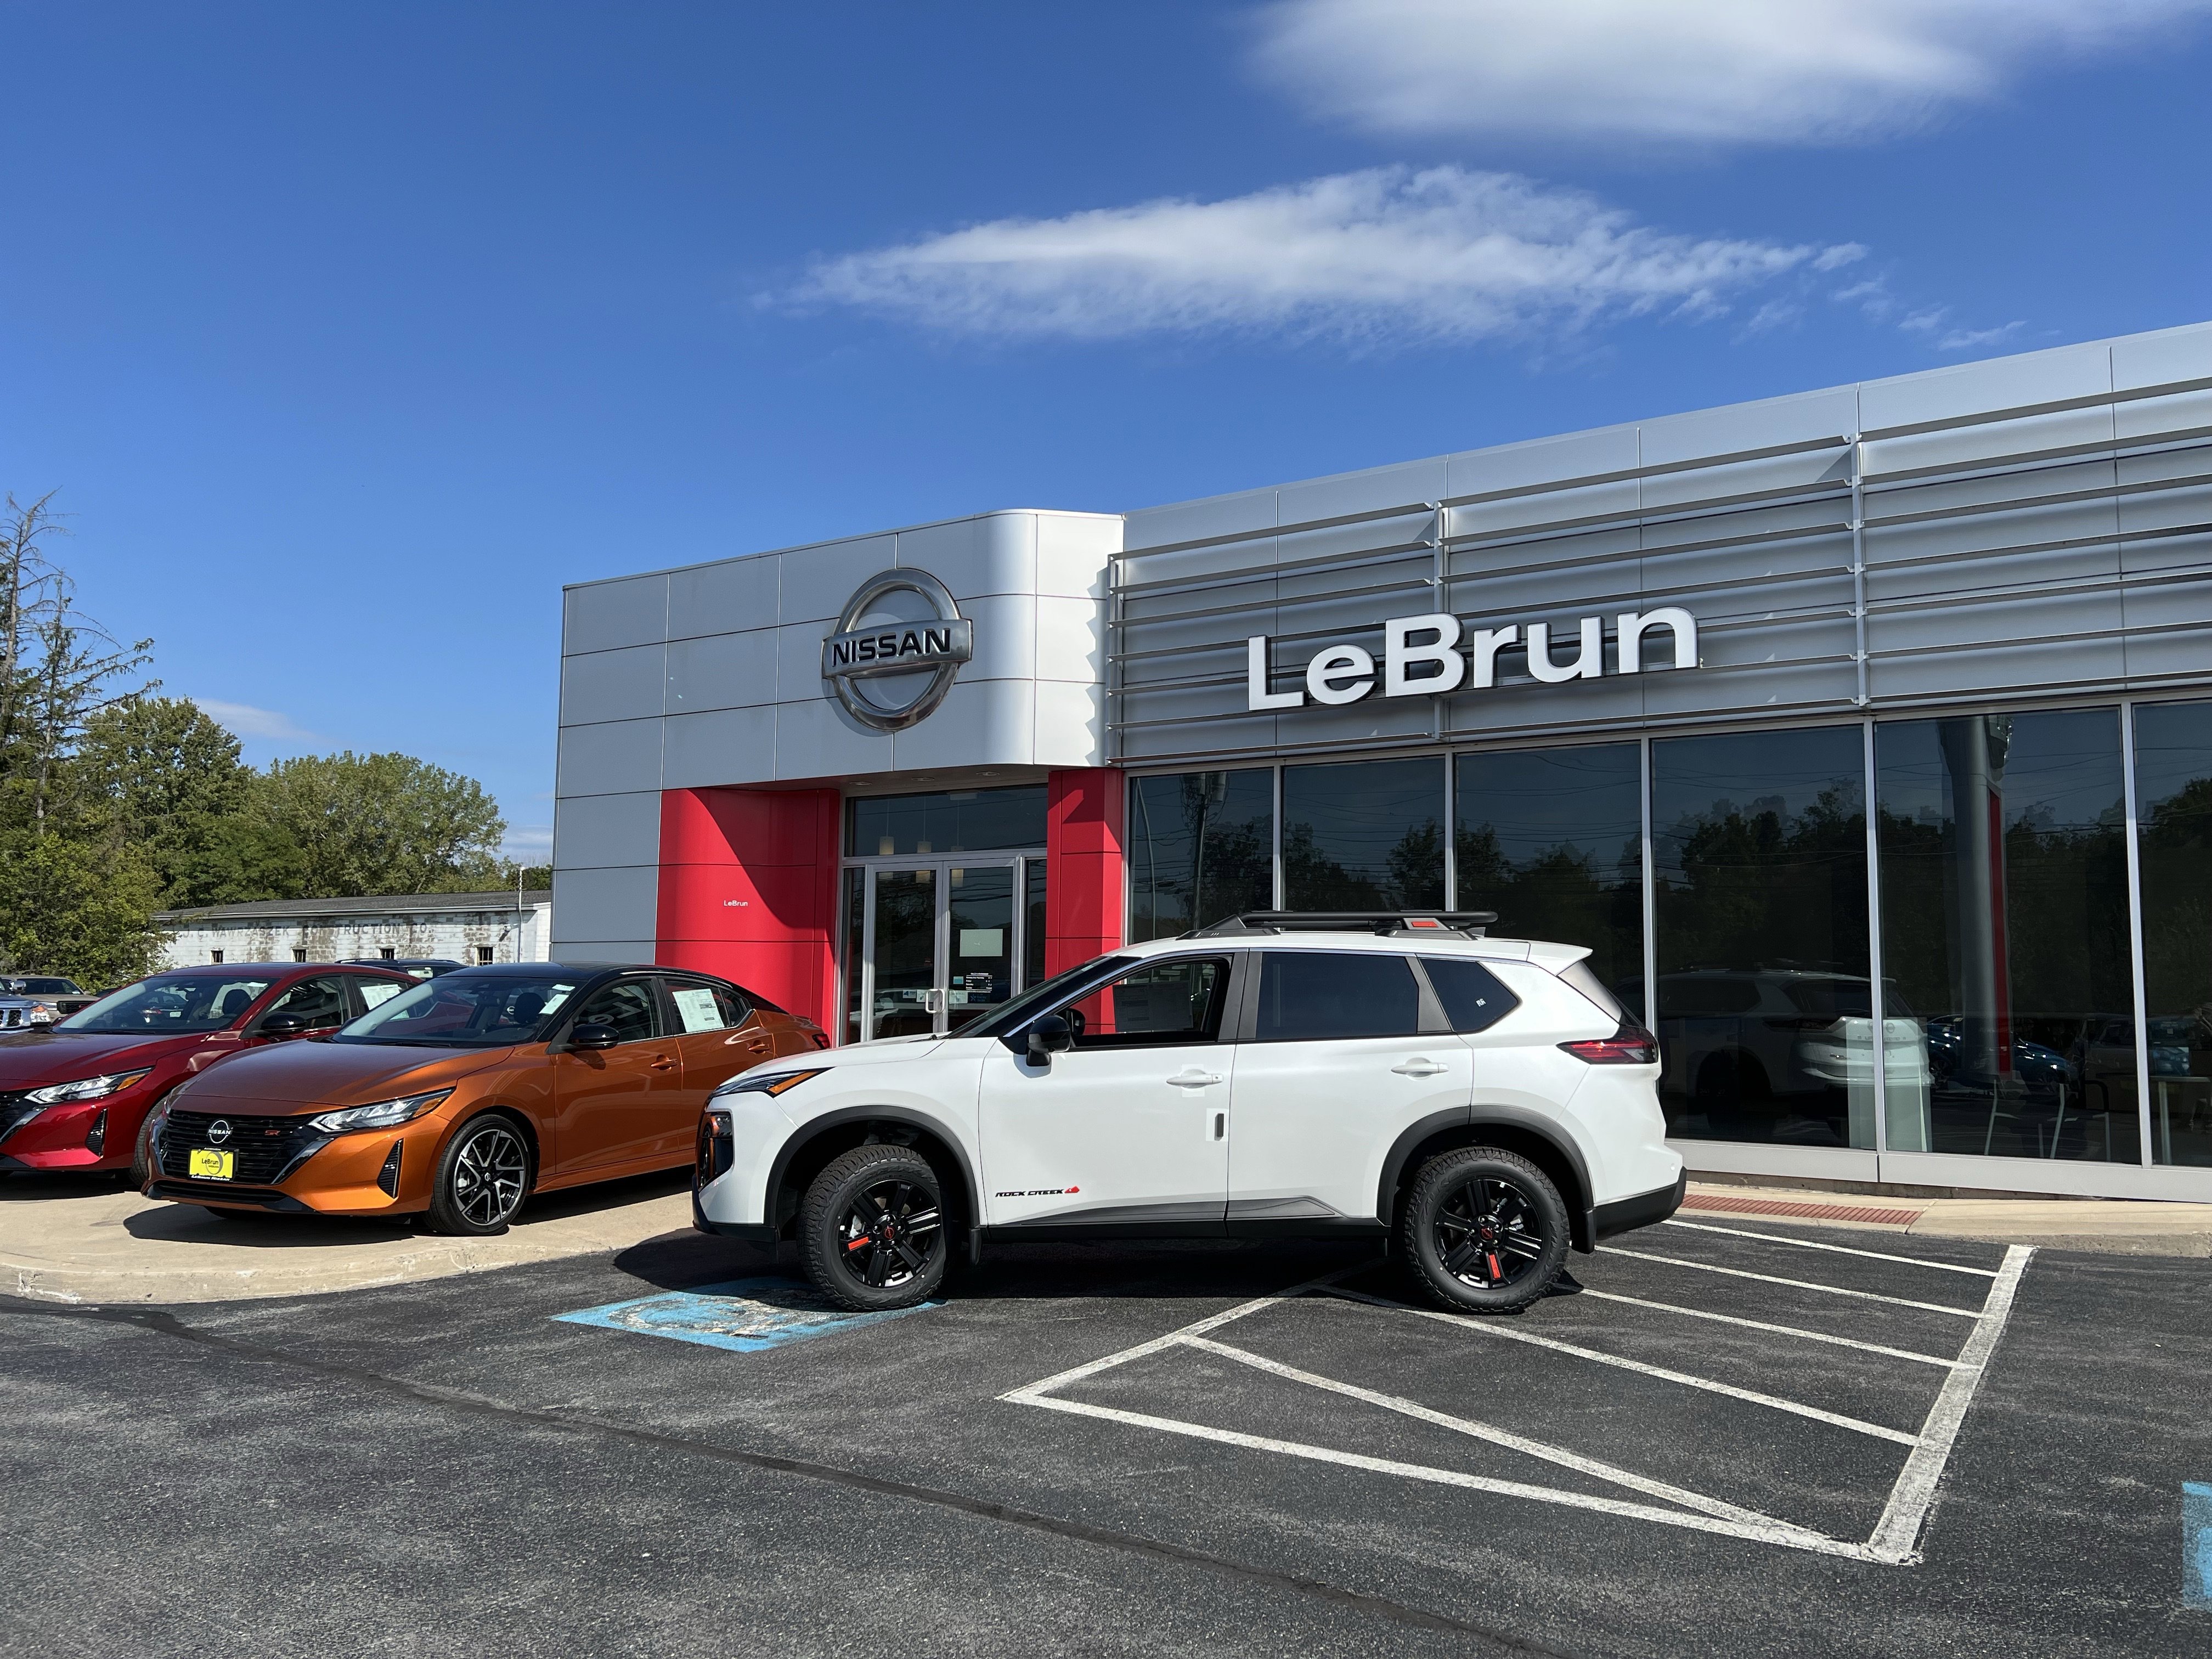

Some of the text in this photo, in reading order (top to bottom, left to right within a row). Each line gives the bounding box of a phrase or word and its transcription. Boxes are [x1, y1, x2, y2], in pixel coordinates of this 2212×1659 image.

[832, 628, 950, 667] NISSAN
[1248, 606, 1699, 711] LeBrun
[303, 923, 400, 936] CONTRUCTION
